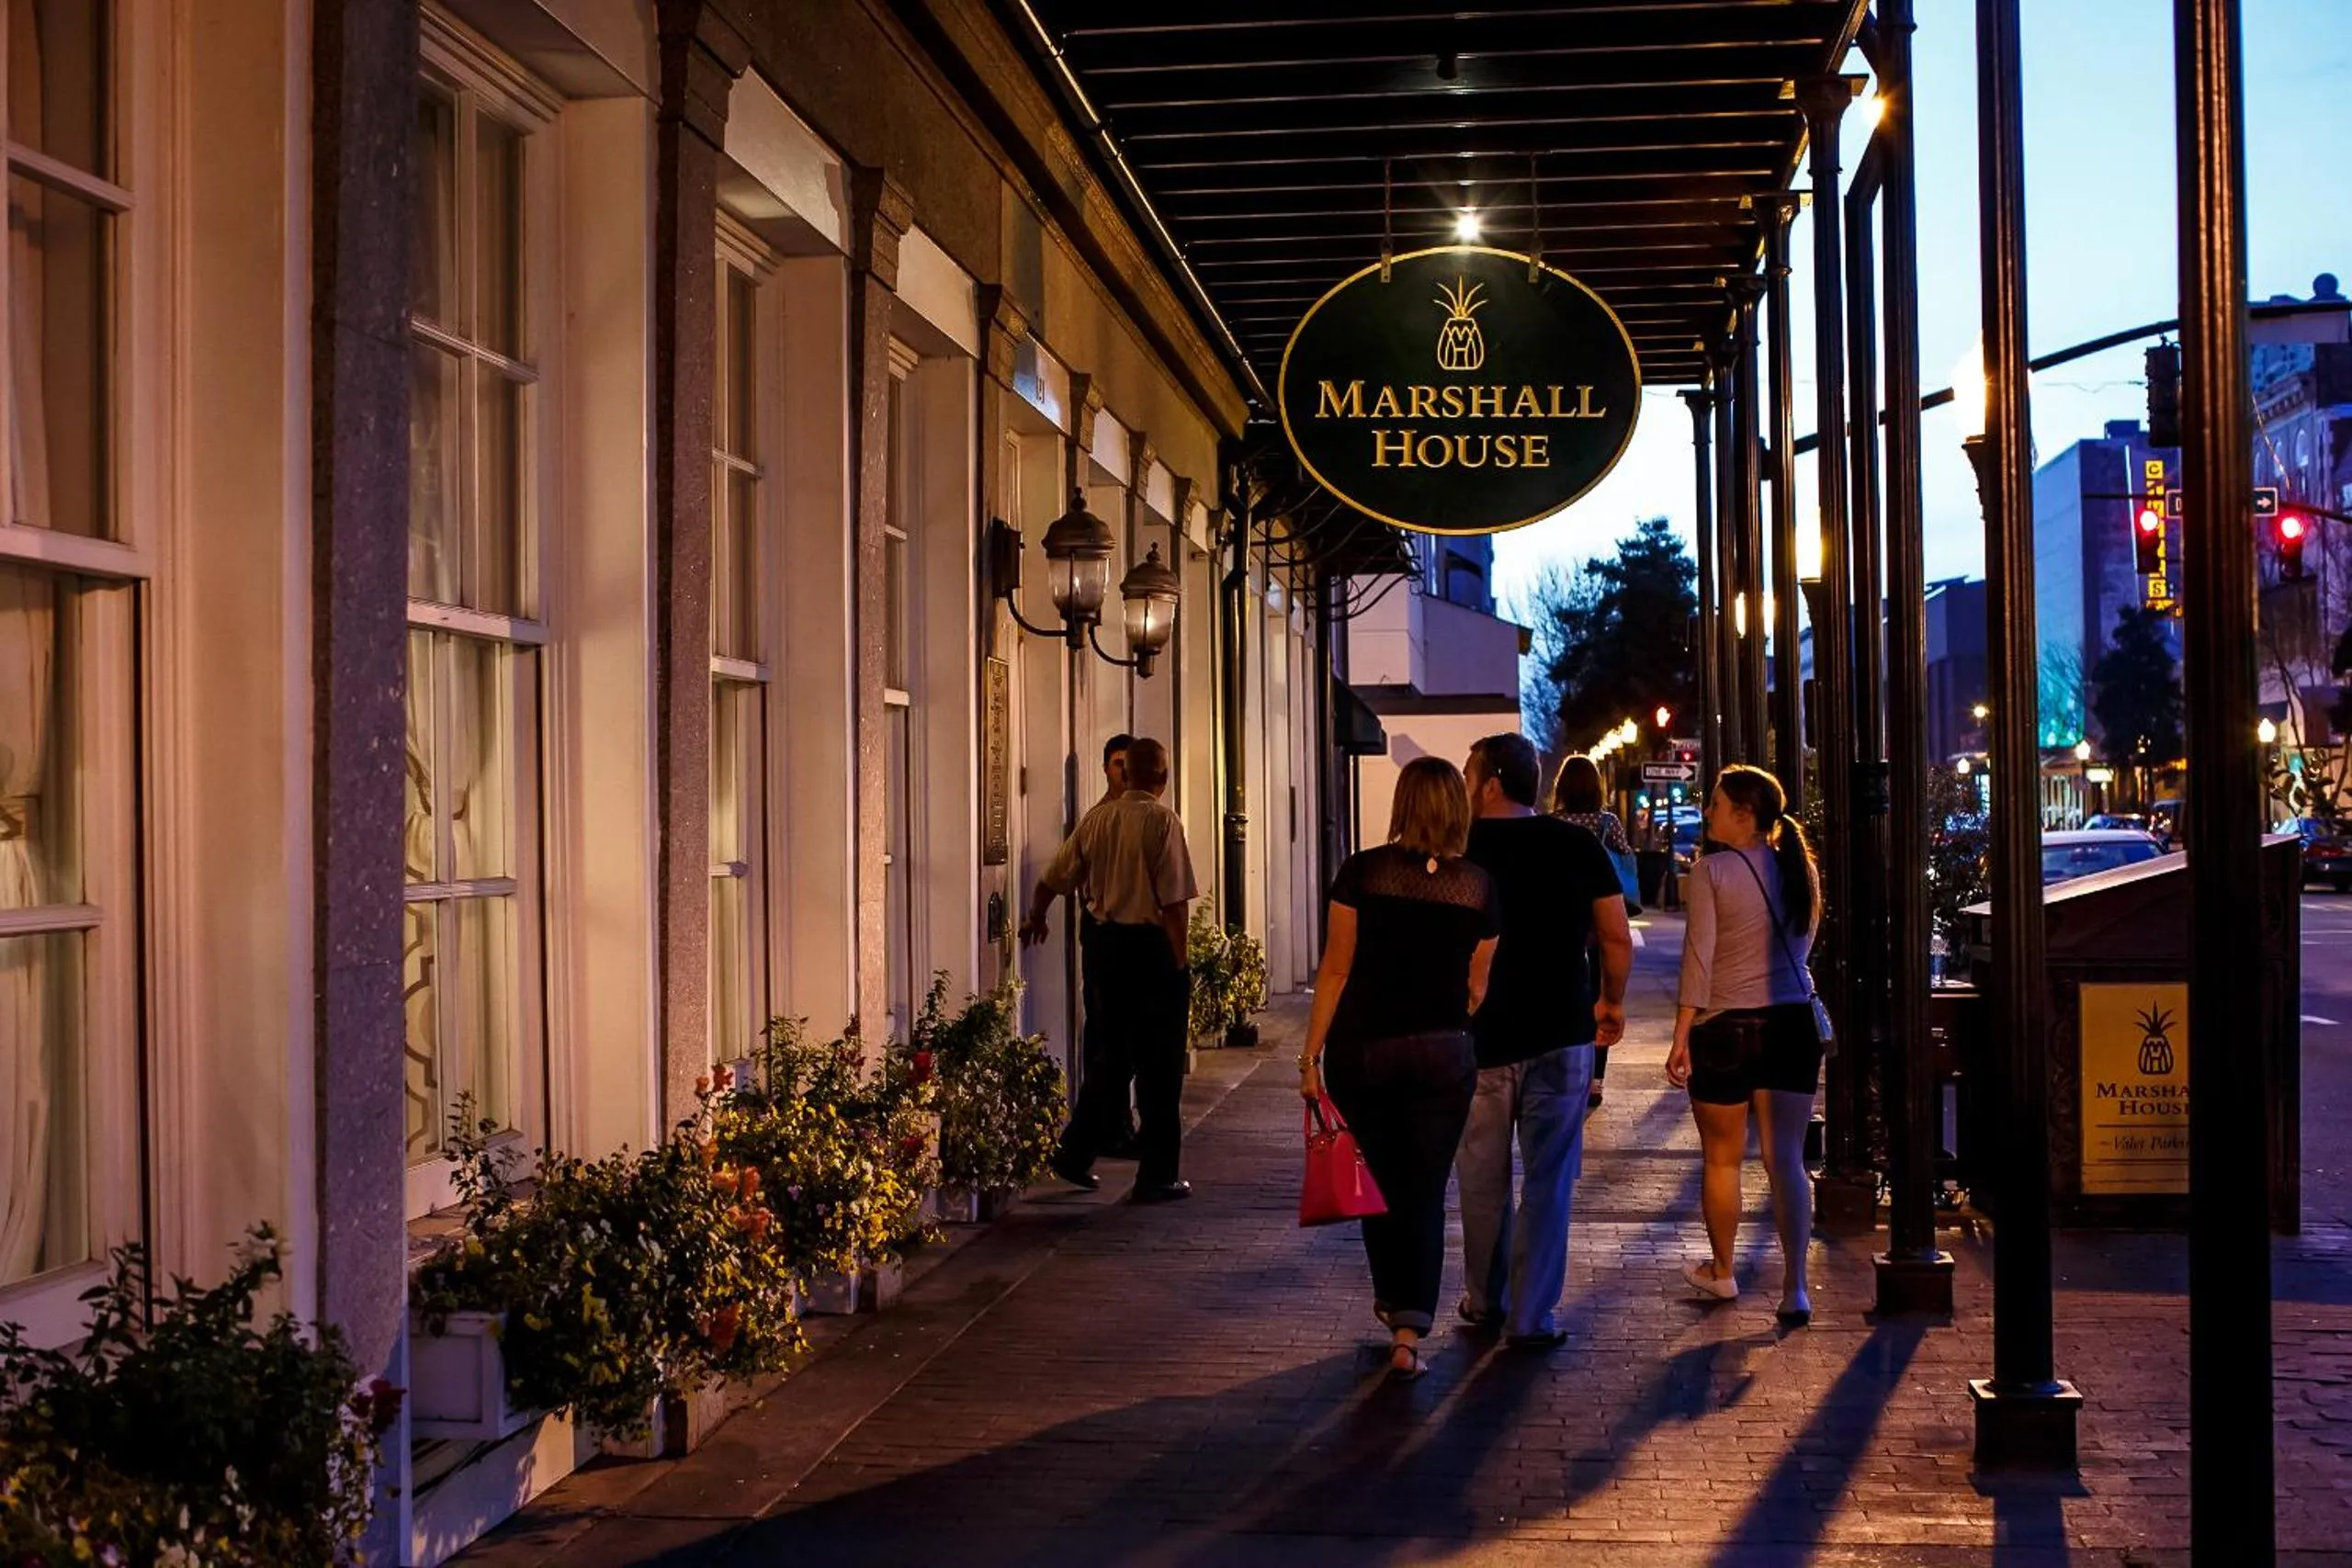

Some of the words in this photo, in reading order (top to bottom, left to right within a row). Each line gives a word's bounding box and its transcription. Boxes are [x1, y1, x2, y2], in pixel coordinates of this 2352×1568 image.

[1315, 380, 1607, 419] MARSHALL
[1372, 429, 1550, 468] HOUSE
[2096, 1083, 2189, 1098] MARSHA
